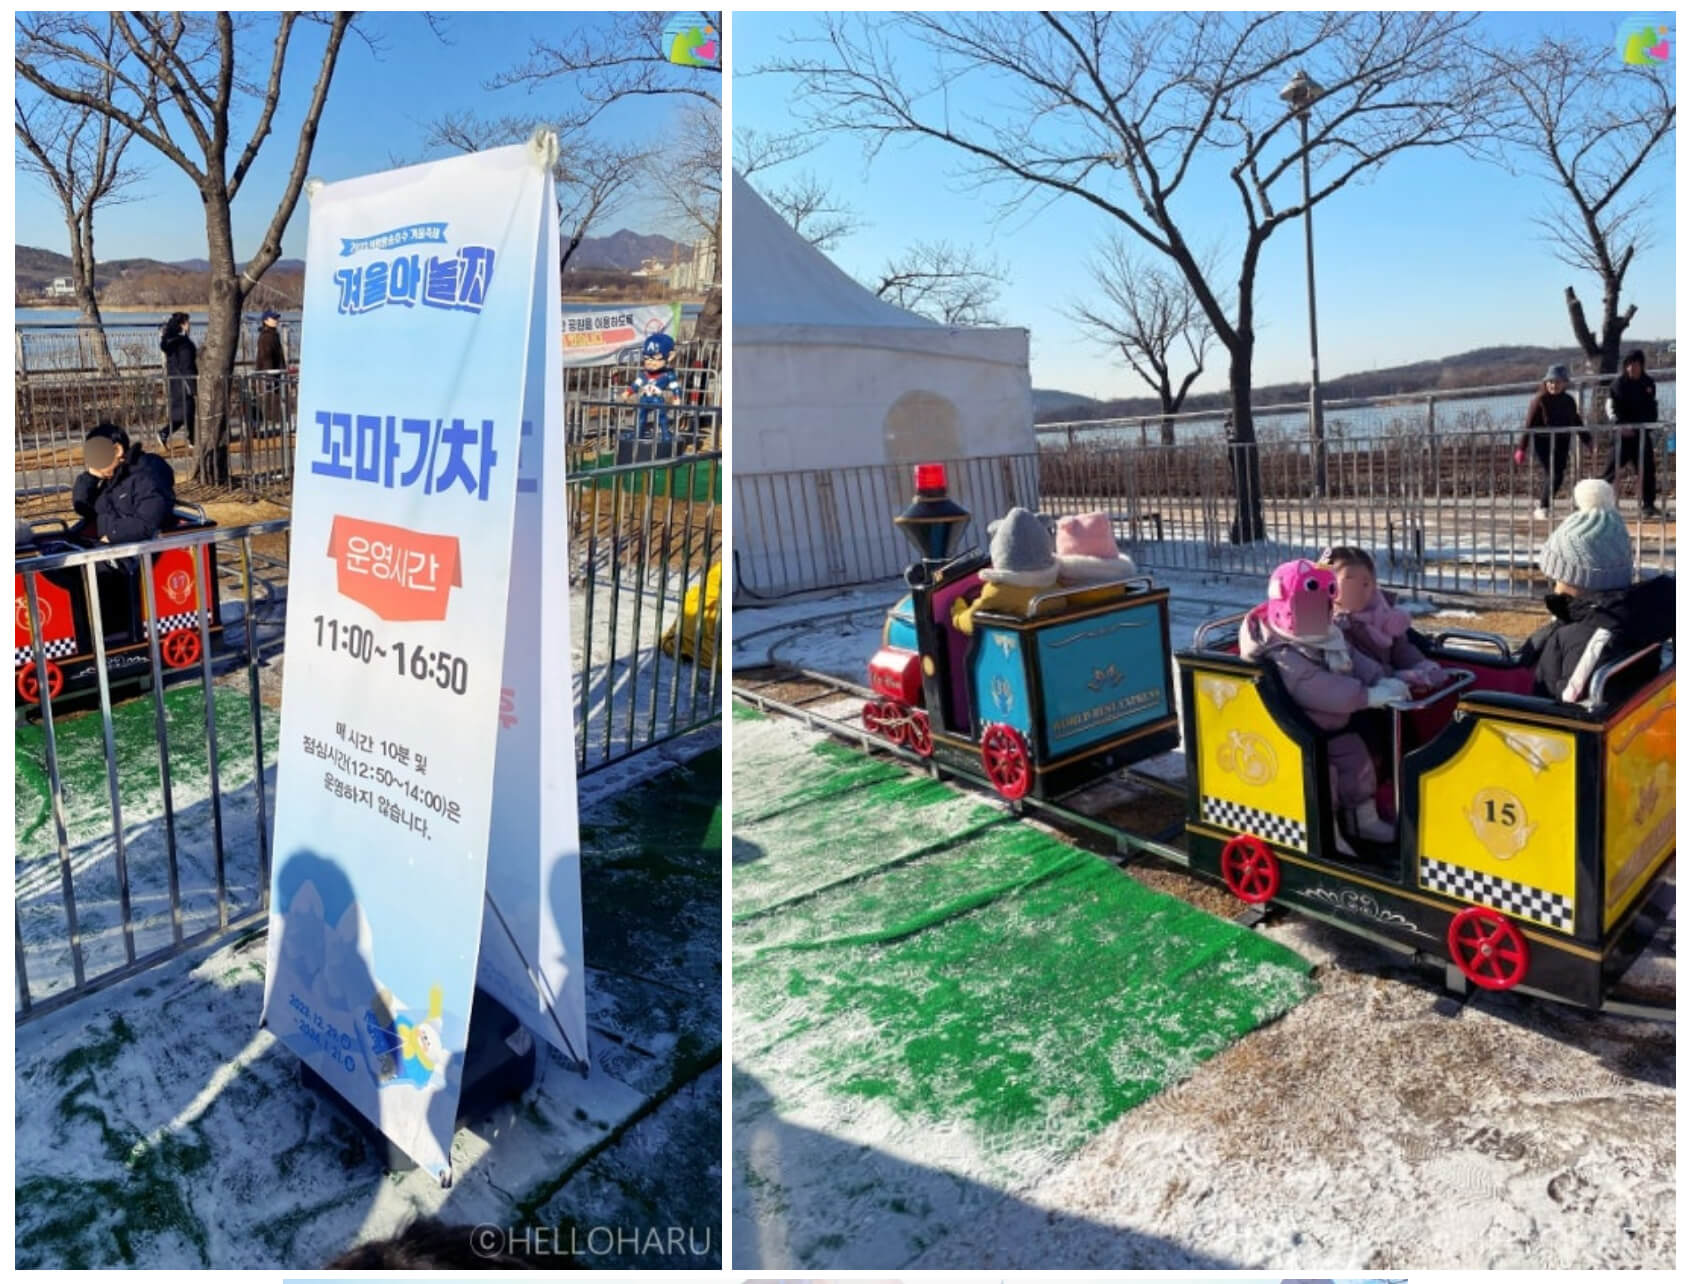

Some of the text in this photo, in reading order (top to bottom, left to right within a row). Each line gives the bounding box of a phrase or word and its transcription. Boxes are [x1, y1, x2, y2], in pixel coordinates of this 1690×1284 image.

[333, 246, 496, 315] 겨울아 놀자
[311, 410, 498, 501] 꼬마기차
[346, 535, 440, 592] 운영시간
[303, 735, 461, 824] 점심시간(12:50~14:00)은
[380, 741, 410, 766] 10분
[415, 753, 427, 775] 및
[324, 771, 431, 841] 운영하지 않습니다.
[1483, 799, 1517, 826] 15
